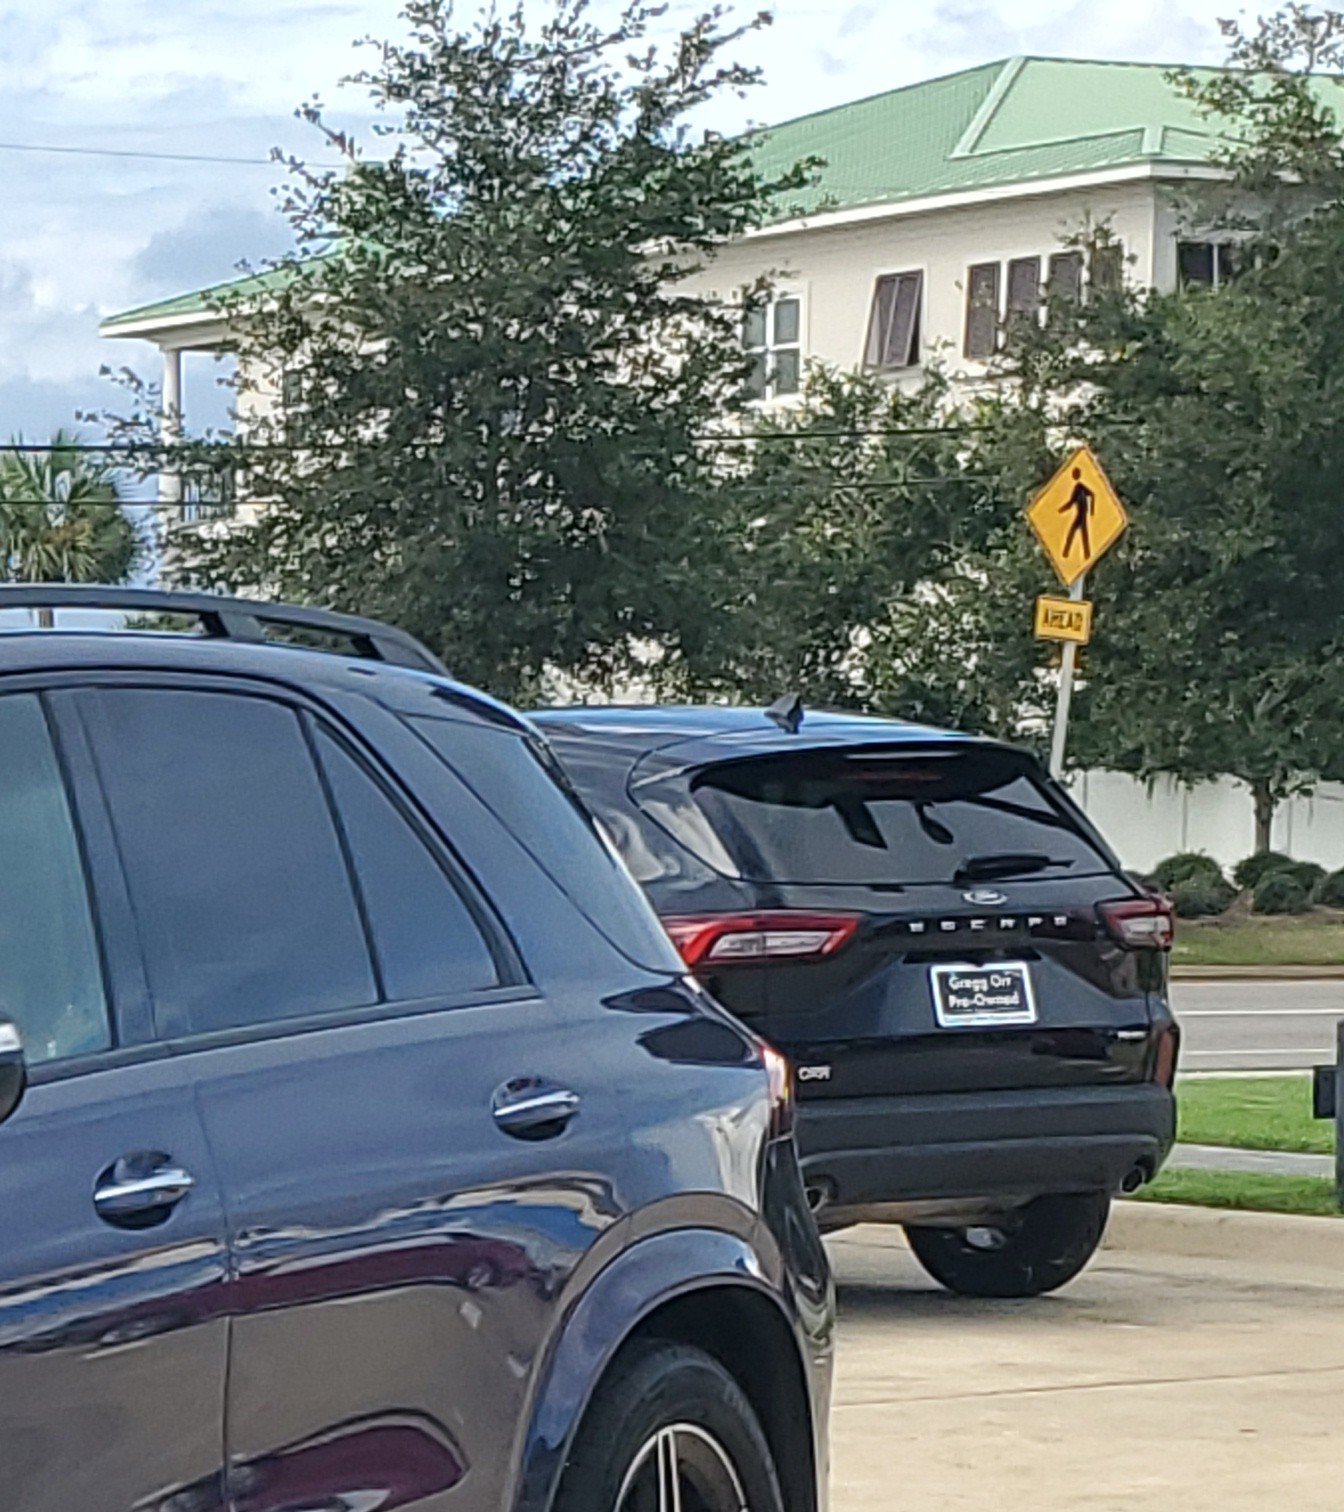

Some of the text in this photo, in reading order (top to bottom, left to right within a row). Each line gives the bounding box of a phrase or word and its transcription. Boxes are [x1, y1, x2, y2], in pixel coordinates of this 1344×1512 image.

[1043, 608, 1083, 632] AHEAD
[990, 973, 1012, 988] Orr
[948, 991, 1020, 1008] Pre-Owned
